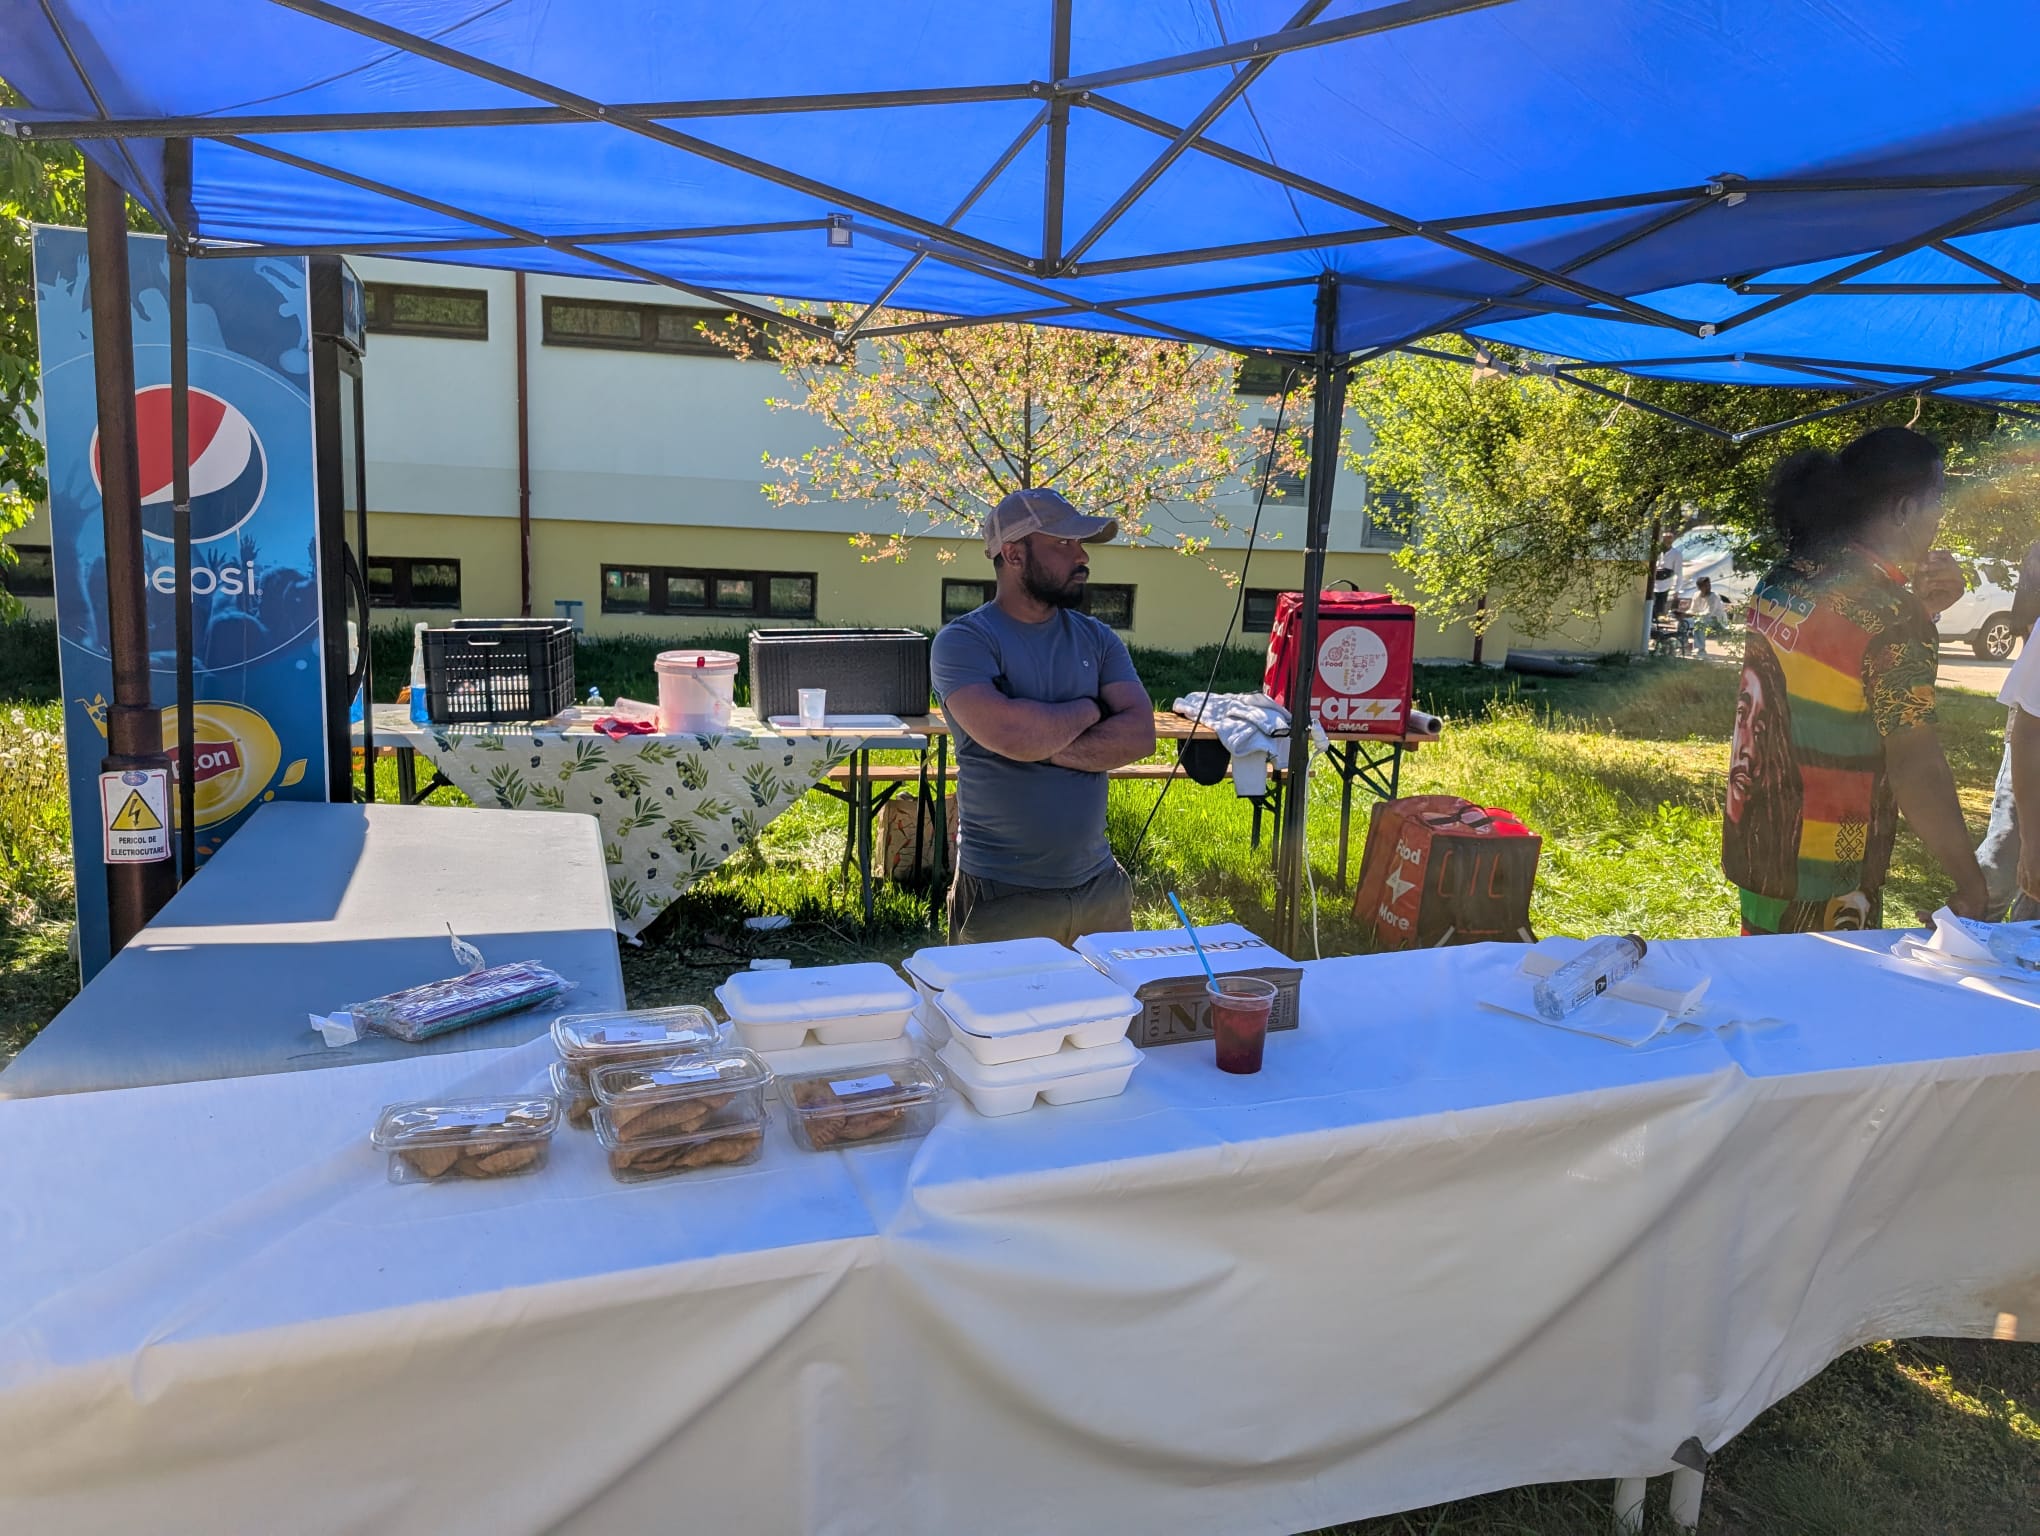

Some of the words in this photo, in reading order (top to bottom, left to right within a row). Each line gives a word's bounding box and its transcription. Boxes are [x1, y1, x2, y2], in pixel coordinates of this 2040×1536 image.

[144, 560, 255, 603] epsi
[119, 836, 146, 845] PERICOL
[148, 835, 157, 843] DE
[111, 846, 164, 856] ELECTROCUTARE
[1378, 903, 1410, 930] More
[1111, 939, 1265, 960] DONATION
